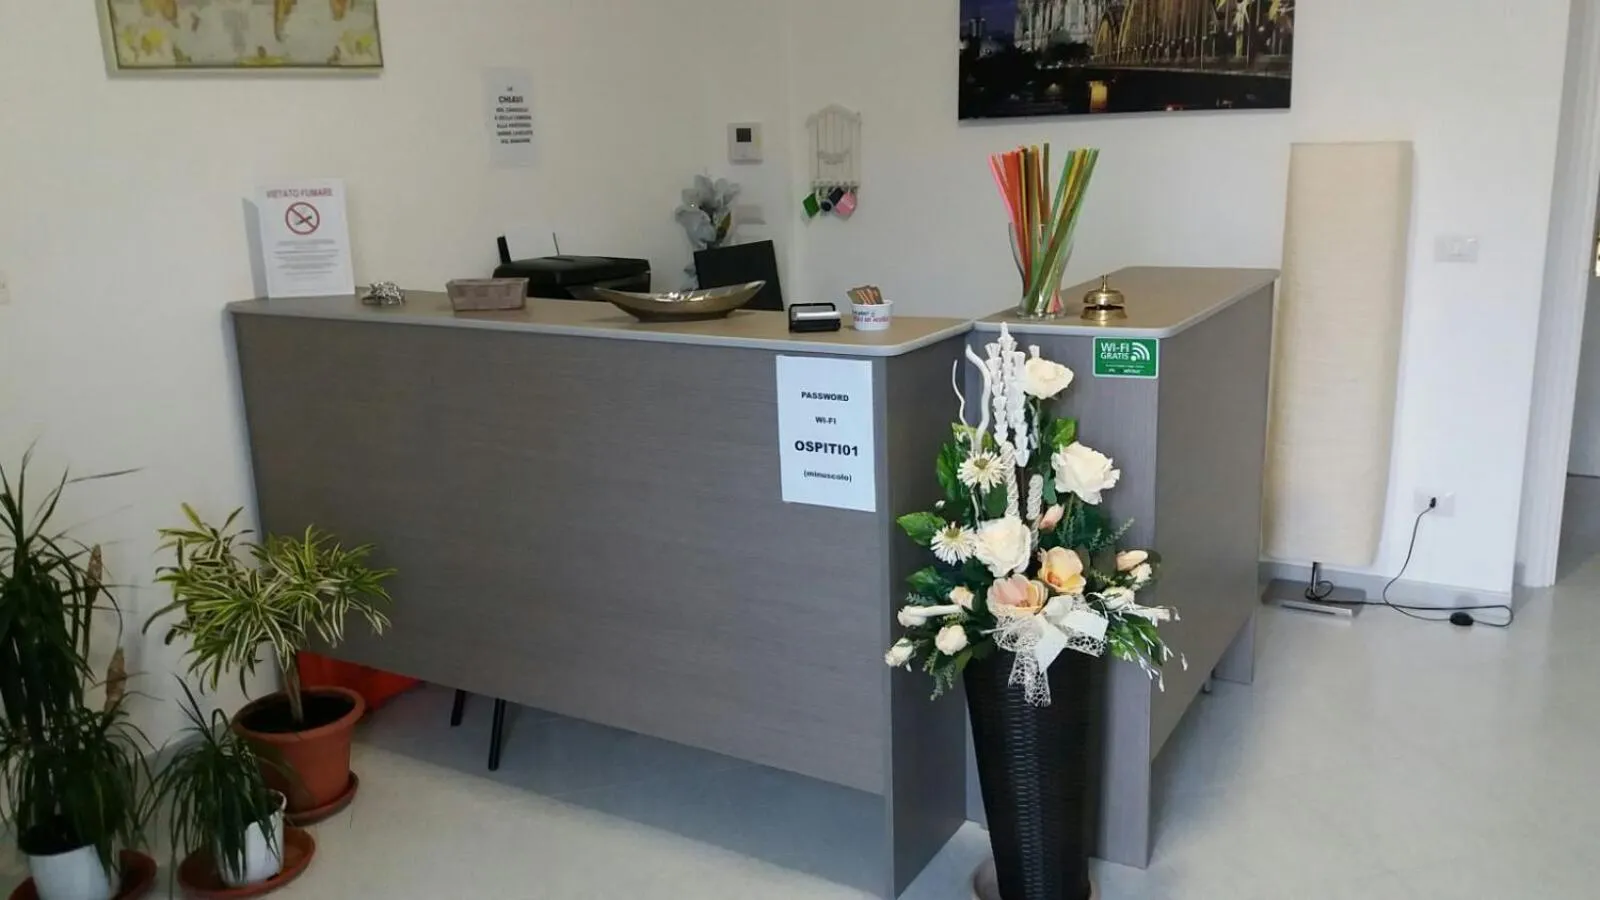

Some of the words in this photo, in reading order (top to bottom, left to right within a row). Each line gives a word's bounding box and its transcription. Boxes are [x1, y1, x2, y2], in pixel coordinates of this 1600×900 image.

[266, 188, 299, 198] VIETATO
[300, 187, 333, 197] FUMARE
[1100, 342, 1130, 352] WI-FI
[1100, 352, 1129, 360] GRATIS
[801, 391, 849, 402] PASSWORD
[815, 416, 837, 425] WI-FI
[794, 440, 858, 457] OSPITI01
[803, 470, 852, 483] (minuscolo)
